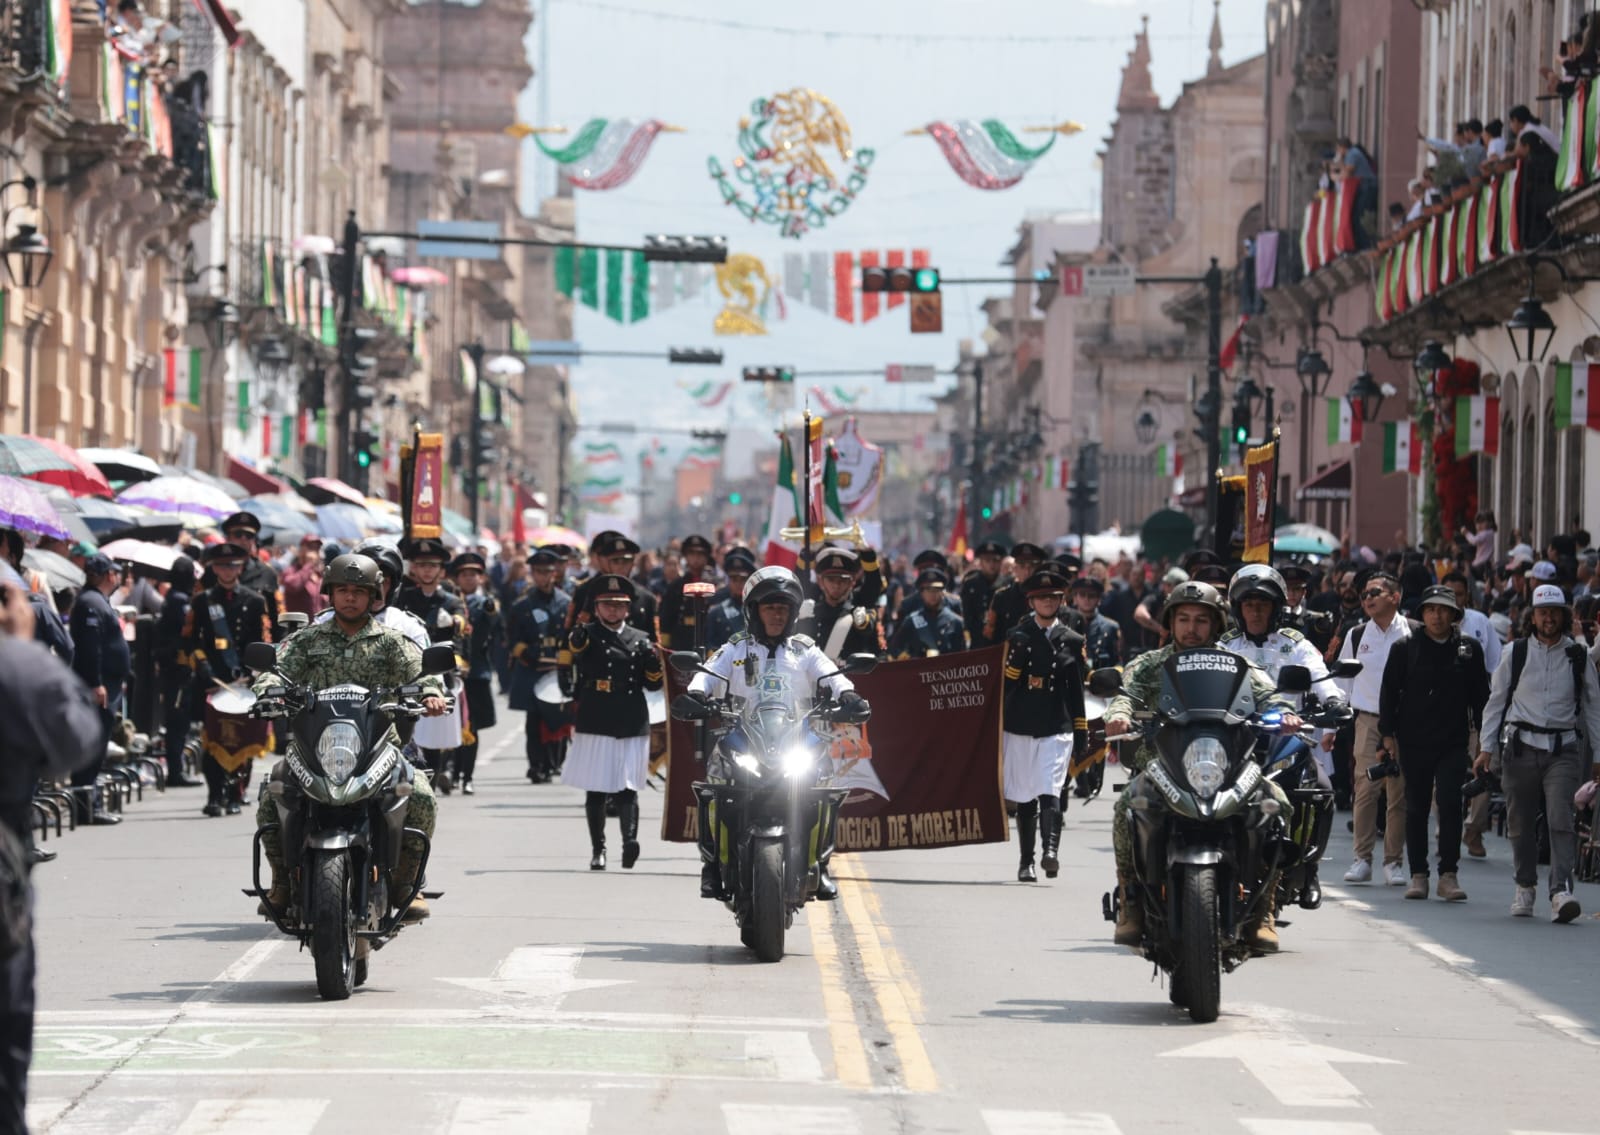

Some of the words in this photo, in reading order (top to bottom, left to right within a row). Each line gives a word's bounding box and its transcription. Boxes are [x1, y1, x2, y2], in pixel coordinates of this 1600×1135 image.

[1178, 652, 1236, 665] EJÉRCITO
[1176, 662, 1238, 673] MEXICANO
[931, 680, 983, 696] NACIONAL
[317, 693, 365, 702] MEXICANO
[929, 698, 944, 711] DE
[947, 693, 985, 708] MÉXICO
[836, 815, 881, 849] OGICO
[887, 814, 909, 847] DE
[910, 808, 983, 845] MORELIA
